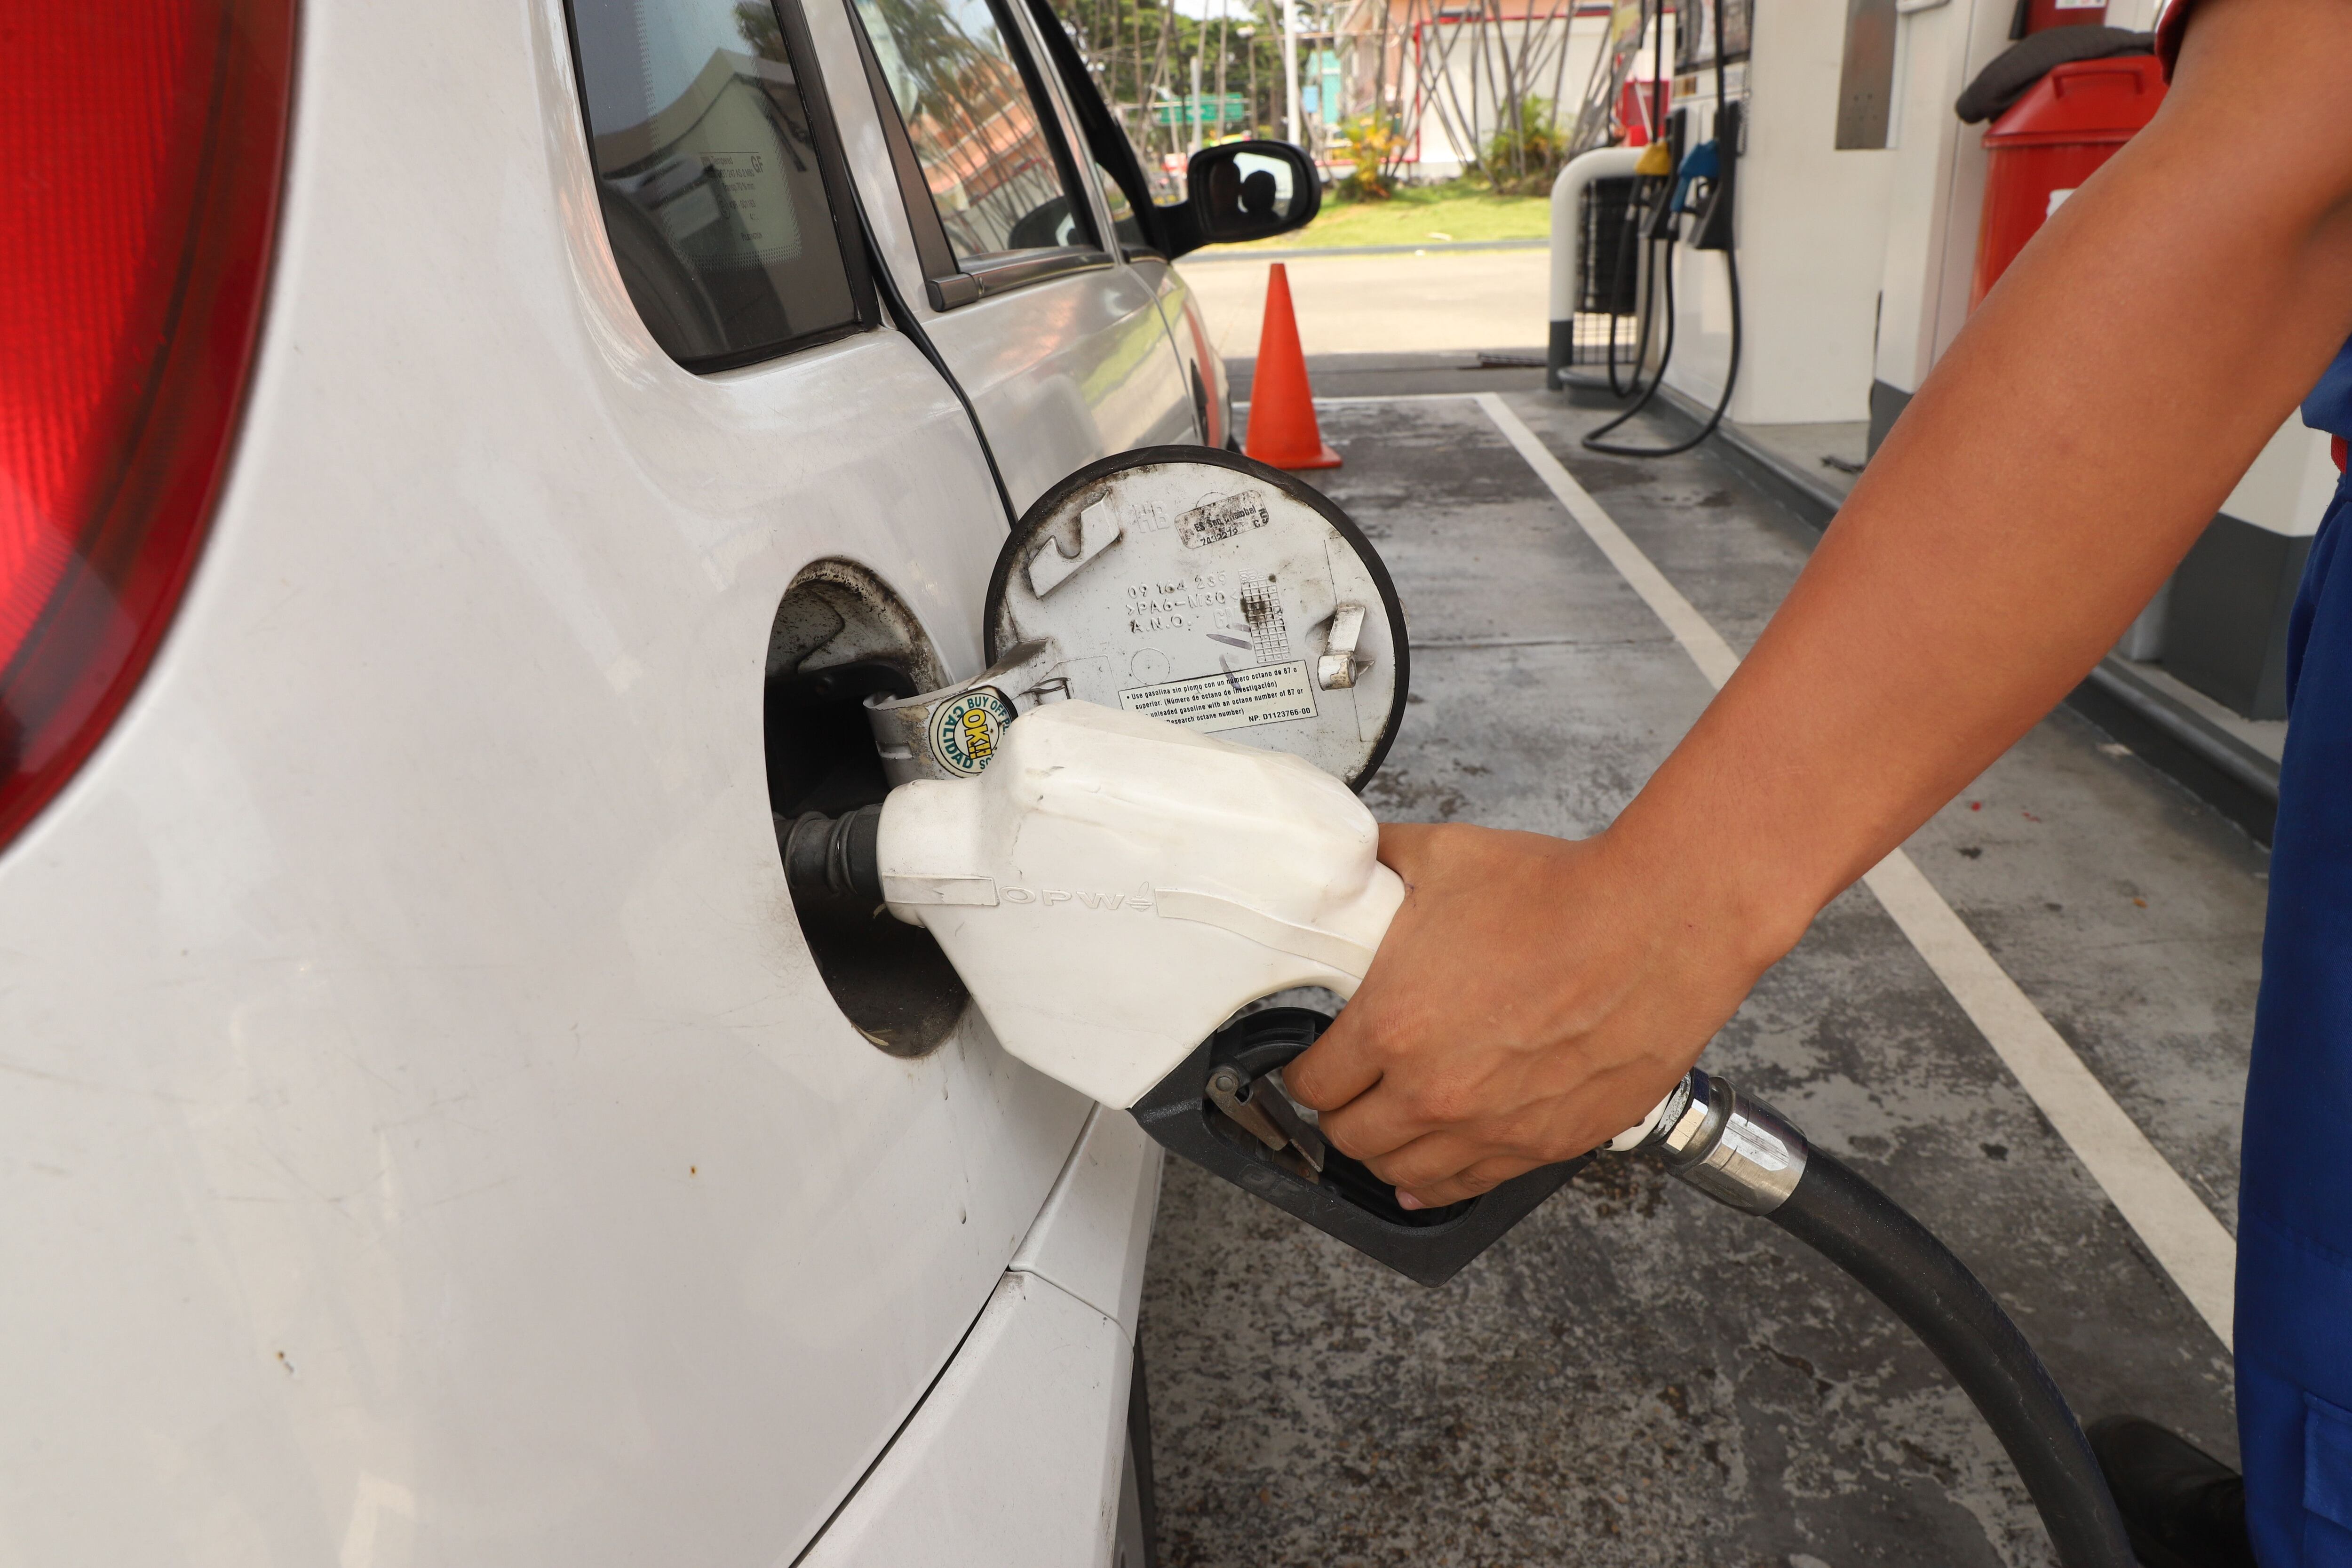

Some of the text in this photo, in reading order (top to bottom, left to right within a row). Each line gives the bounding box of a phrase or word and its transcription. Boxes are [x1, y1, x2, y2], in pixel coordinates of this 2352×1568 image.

[751, 155, 763, 173] GF
[1128, 583, 1148, 599] 09
[1156, 578, 1187, 595] 164
[1145, 689, 1170, 699] gasolina
[1184, 684, 1202, 692] plomo
[1227, 675, 1249, 685] número
[967, 696, 989, 709] BUY
[990, 700, 1007, 717] OFF
[1135, 700, 1162, 710] superior.
[1164, 696, 1190, 705] (Número
[1201, 691, 1222, 700] octano
[1151, 708, 1178, 717] unleaded
[1180, 704, 1206, 714] gasoline
[1232, 696, 1253, 705] octane
[1254, 692, 1278, 701] number
[1196, 711, 1217, 721] octane
[1218, 708, 1245, 716] number)
[1263, 707, 1311, 720] D1123766-00
[943, 706, 974, 769] CALIDAD
[962, 708, 993, 760] OK!!
[999, 886, 1125, 910] OPW
